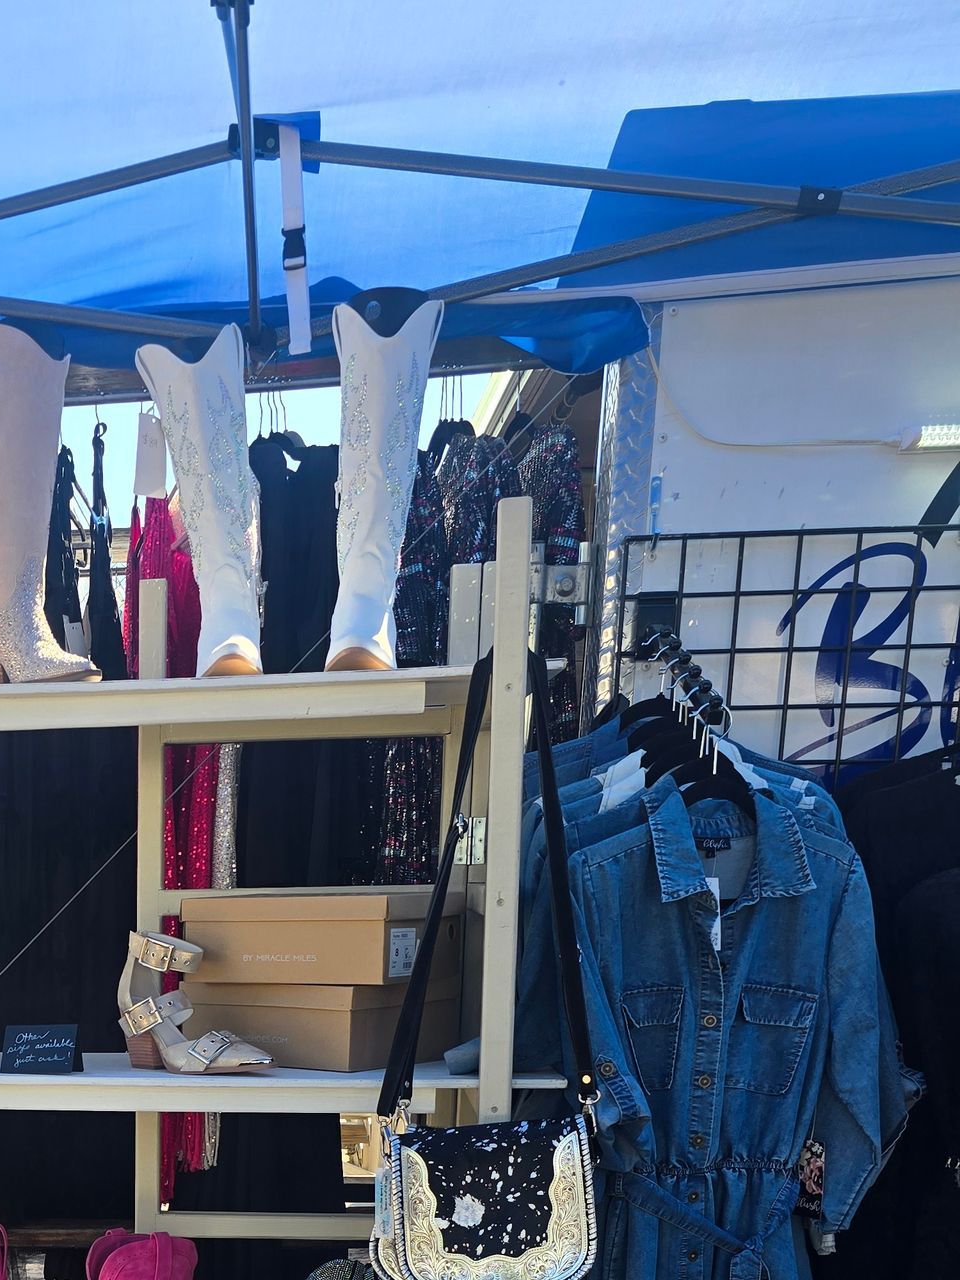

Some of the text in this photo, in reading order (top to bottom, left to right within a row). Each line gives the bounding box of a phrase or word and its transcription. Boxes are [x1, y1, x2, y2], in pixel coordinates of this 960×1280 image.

[777, 542, 960, 792] B
[242, 954, 317, 962] BY MIRACLE MILES
[15, 1030, 50, 1043] Other
[35, 1038, 75, 1049] available
[14, 1054, 35, 1068] just
